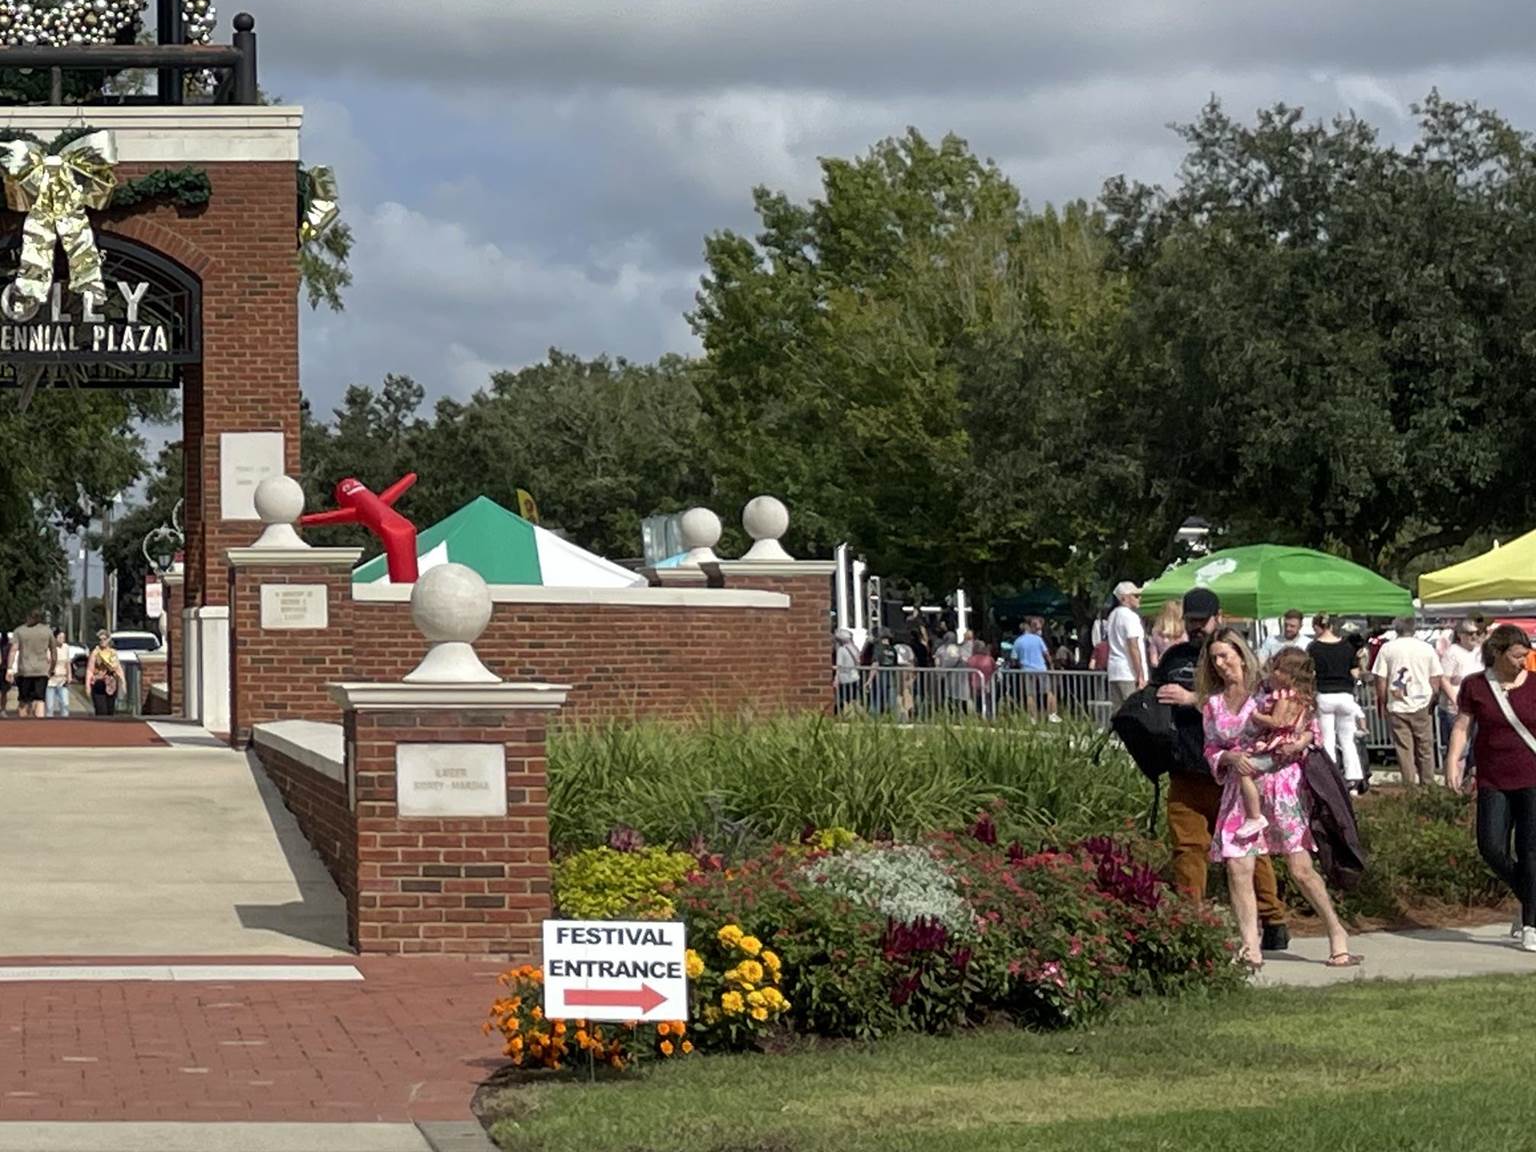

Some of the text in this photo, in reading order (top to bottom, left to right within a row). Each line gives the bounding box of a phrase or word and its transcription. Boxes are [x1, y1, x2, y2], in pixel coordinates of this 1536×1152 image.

[93, 324, 168, 353] PLAZA
[556, 927, 673, 946] FESTIVAL
[549, 959, 682, 979] ENTRANCE
